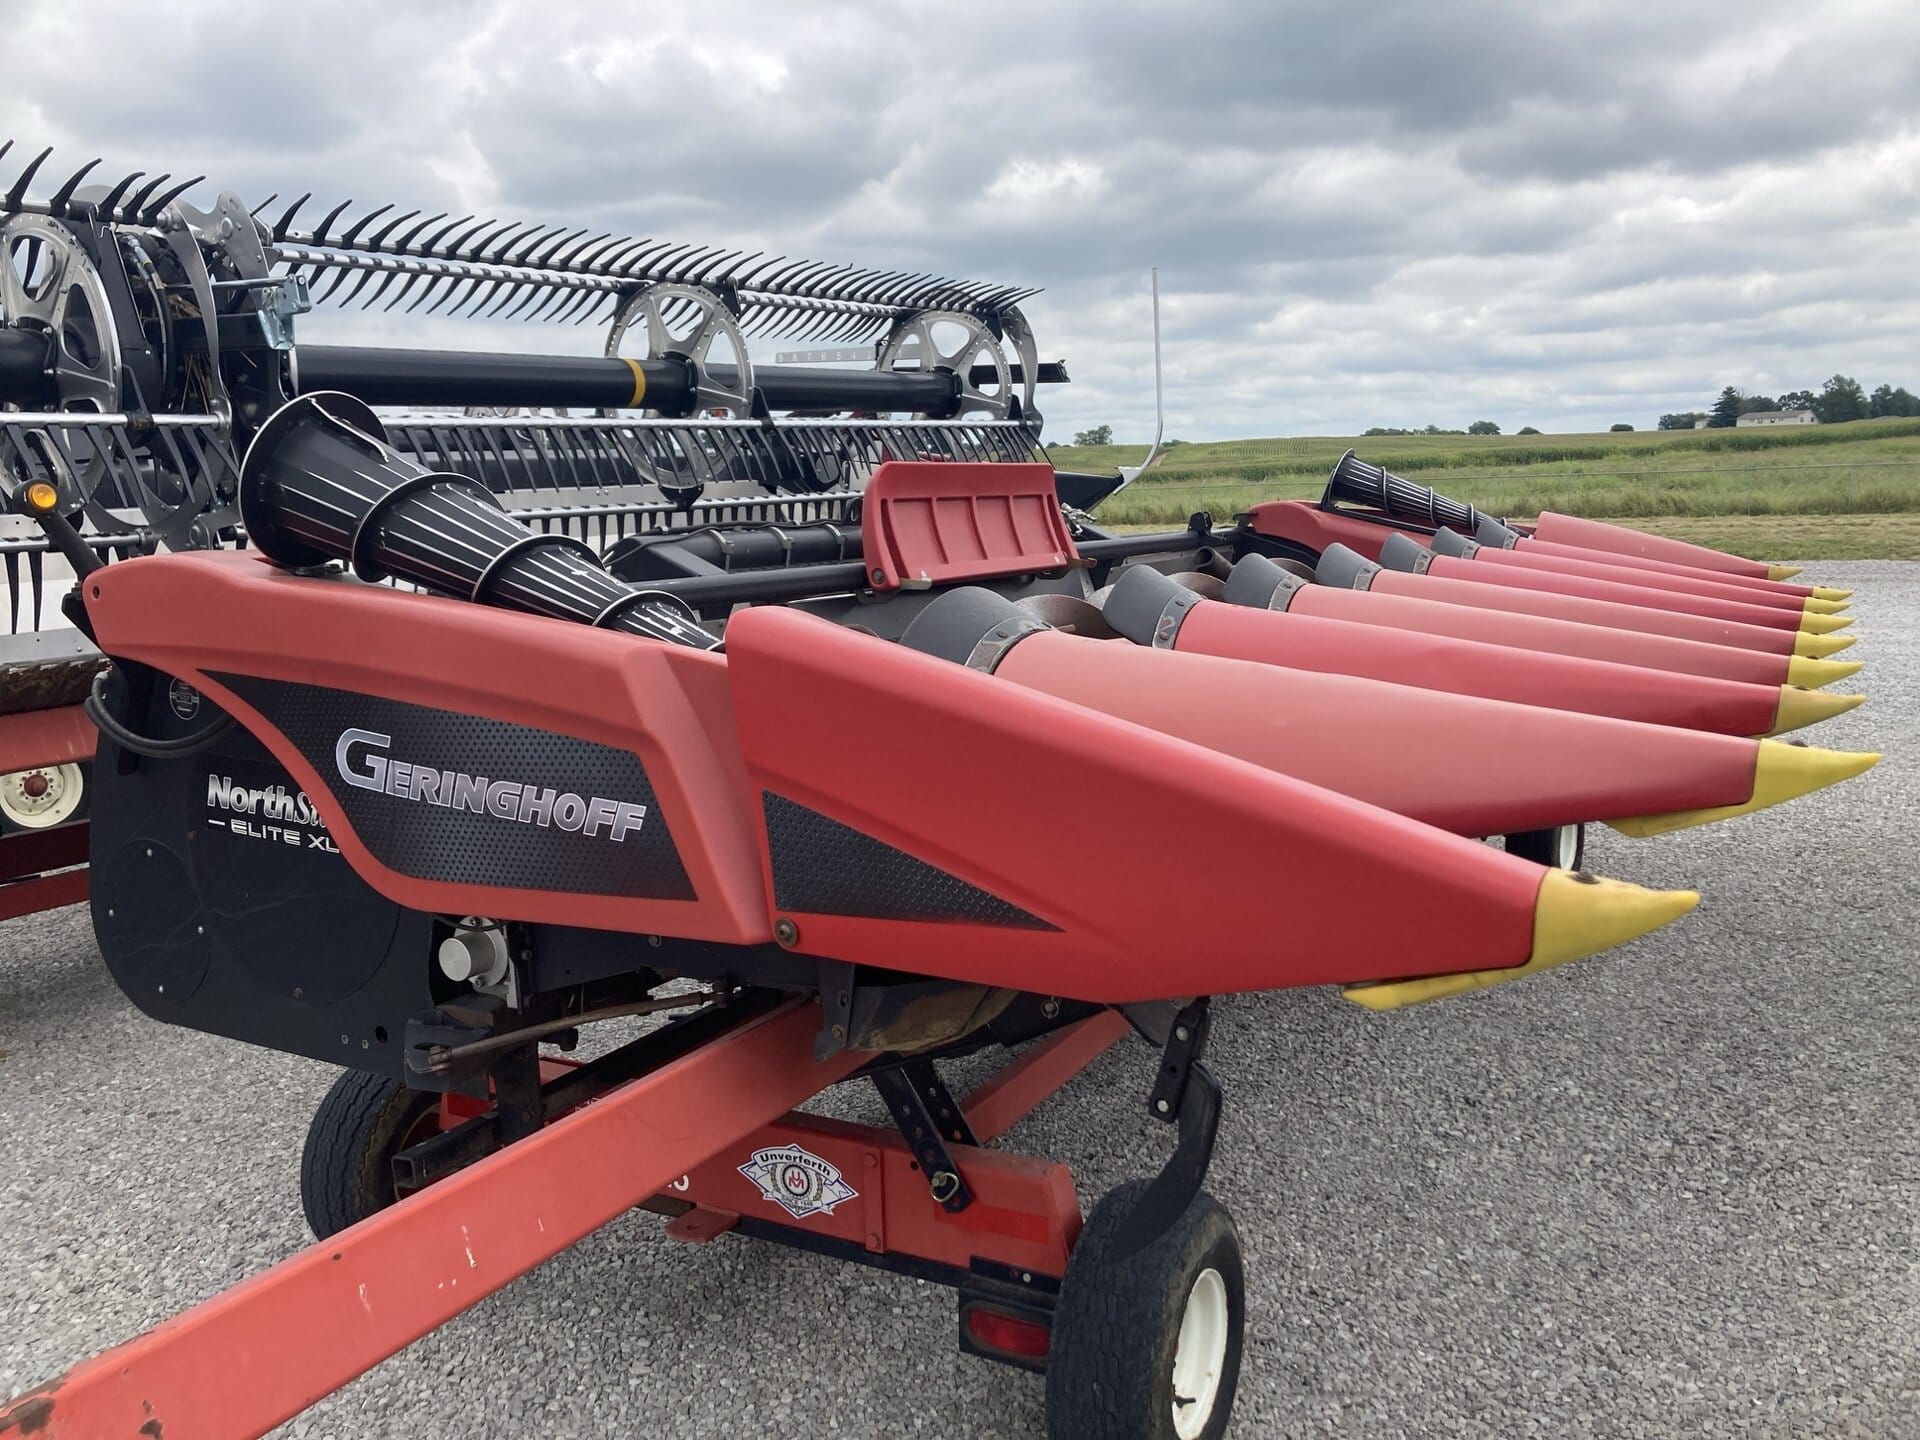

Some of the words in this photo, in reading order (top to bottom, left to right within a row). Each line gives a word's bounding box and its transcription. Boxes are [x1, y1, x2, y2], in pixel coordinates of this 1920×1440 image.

[230, 818, 301, 846] ELITE
[307, 833, 340, 854] XL
[760, 1152, 831, 1177] Unverferth
